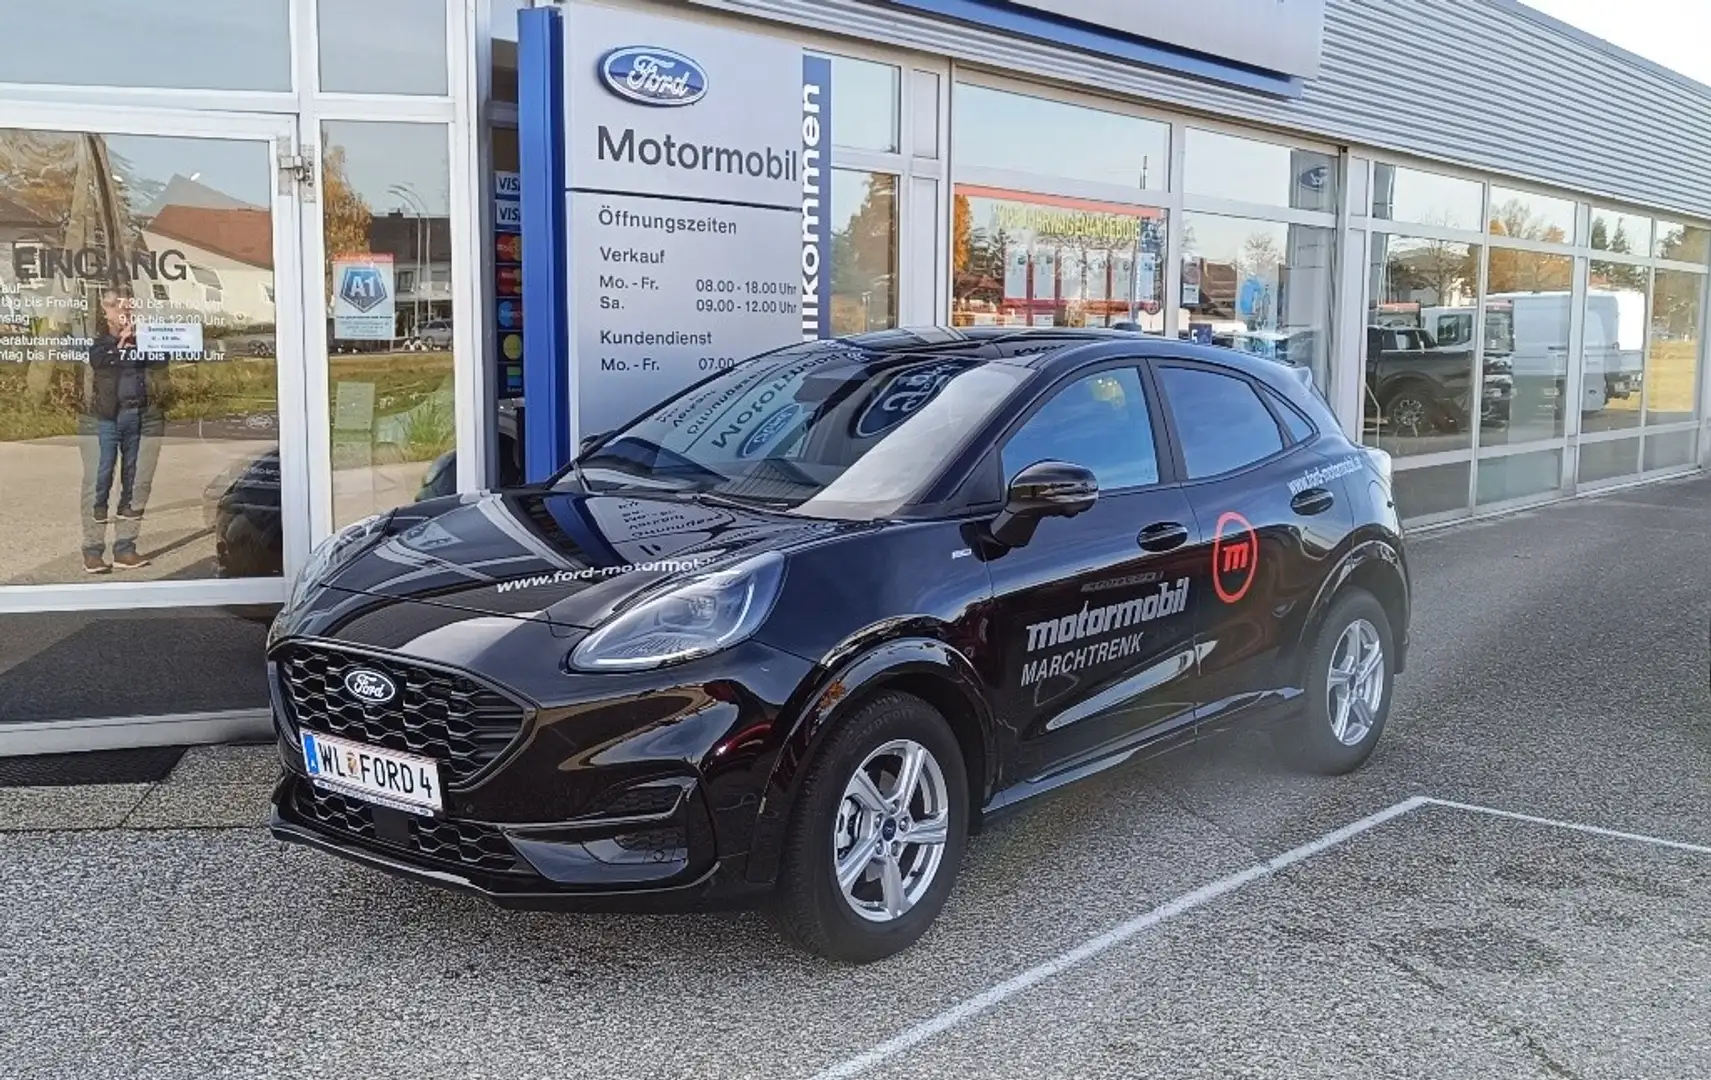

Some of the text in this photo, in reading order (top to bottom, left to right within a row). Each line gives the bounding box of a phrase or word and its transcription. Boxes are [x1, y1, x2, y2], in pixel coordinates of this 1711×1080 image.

[626, 54, 690, 98] Ford
[597, 124, 798, 182] Motormobil
[598, 205, 737, 235] Öffnungszeiten
[801, 83, 821, 341] illkommen
[12, 246, 188, 281] EINGANG
[599, 246, 665, 264] Verkauf
[350, 275, 376, 297] A1
[599, 275, 629, 289] Mo.
[641, 276, 660, 290] Fr.
[696, 279, 735, 293] 08.00
[745, 280, 777, 295] 18.00
[779, 282, 797, 295] Uhr
[599, 296, 625, 309] Sa.
[696, 299, 735, 313] 09.00
[745, 300, 777, 314] 12.00
[779, 301, 797, 314] Uhr
[0, 335, 95, 346] araturannahme
[600, 331, 713, 345] Kundendienst
[27, 349, 45, 361] bis
[48, 350, 90, 364] Freitag
[119, 350, 145, 361] 7.00
[204, 350, 226, 361] Uhr
[600, 358, 630, 371] Mo.
[642, 358, 660, 371] Fr.
[1025, 576, 1191, 652] motormobil
[1020, 632, 1145, 687] MARCHTRENK
[353, 672, 385, 699] Ford
[317, 742, 346, 778] WL
[359, 754, 414, 794] FORD
[419, 767, 433, 799] 4
